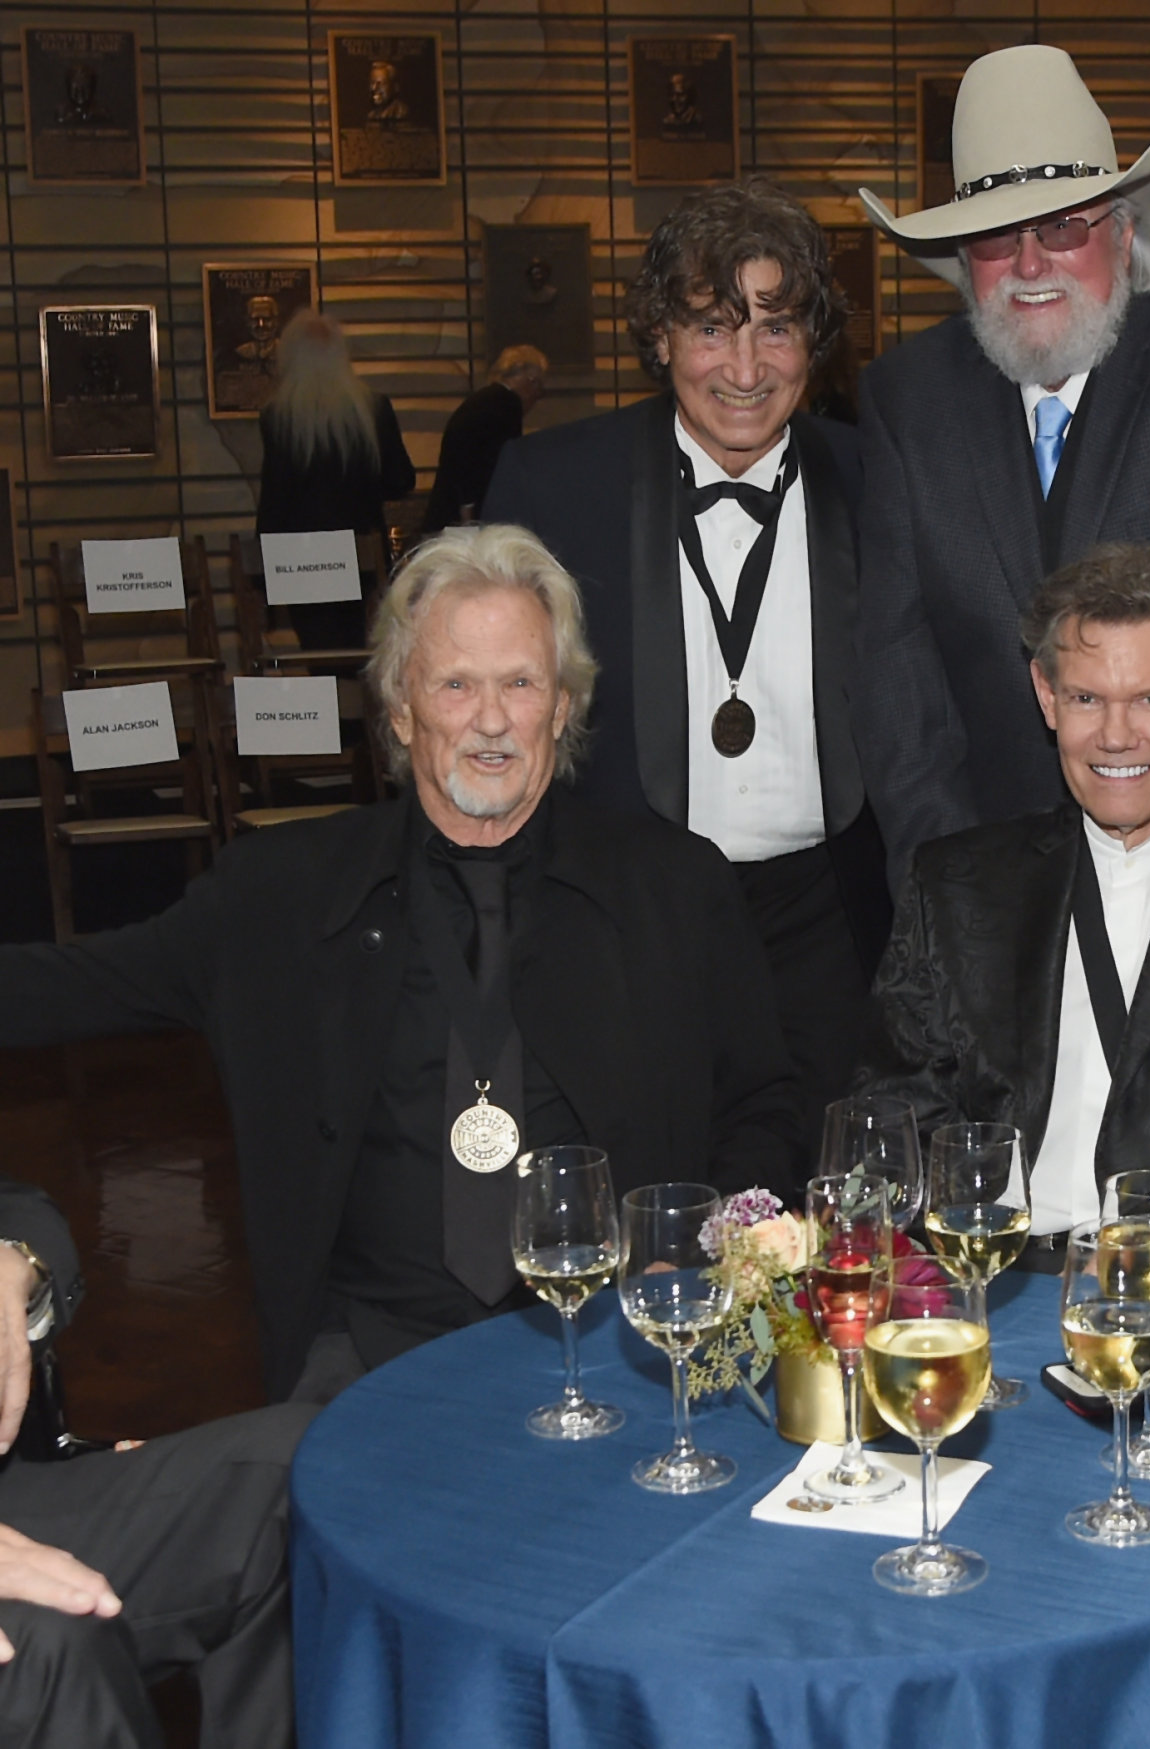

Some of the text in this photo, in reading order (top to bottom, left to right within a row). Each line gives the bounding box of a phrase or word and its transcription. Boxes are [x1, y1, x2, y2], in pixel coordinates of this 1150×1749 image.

[57, 313, 105, 322] COUNTRY
[275, 562, 346, 574] BILL ANDERSON
[122, 572, 144, 581] KRIS
[96, 580, 172, 592] KRISTOFFERSON
[255, 711, 319, 721] DON SCHLITZ
[82, 719, 159, 735] ALAN JACKSON
[460, 1109, 508, 1127] COUNTRY
